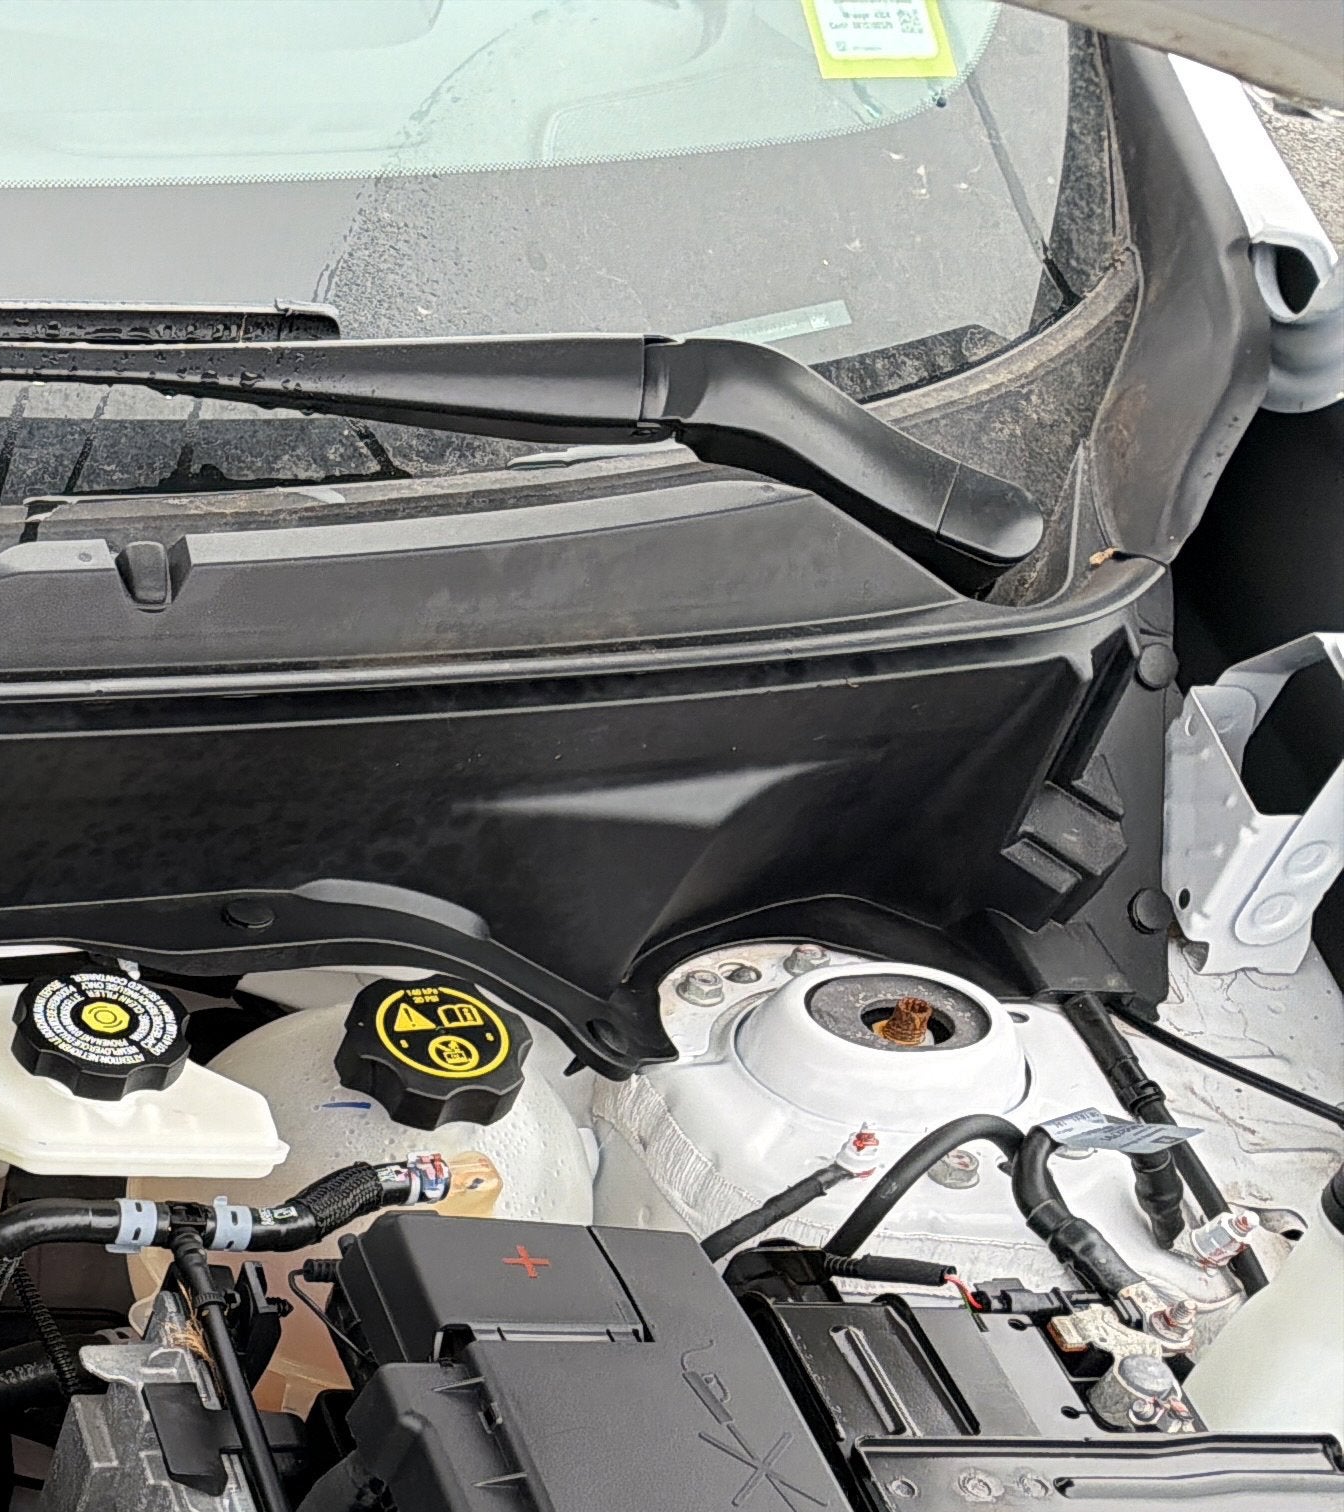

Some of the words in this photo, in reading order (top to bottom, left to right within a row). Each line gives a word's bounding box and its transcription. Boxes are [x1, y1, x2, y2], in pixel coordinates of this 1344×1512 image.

[77, 982, 104, 991] ONLY
[127, 980, 163, 1001] SEALED
[86, 991, 119, 1000] FILLER
[117, 995, 146, 1014] CLEAN
